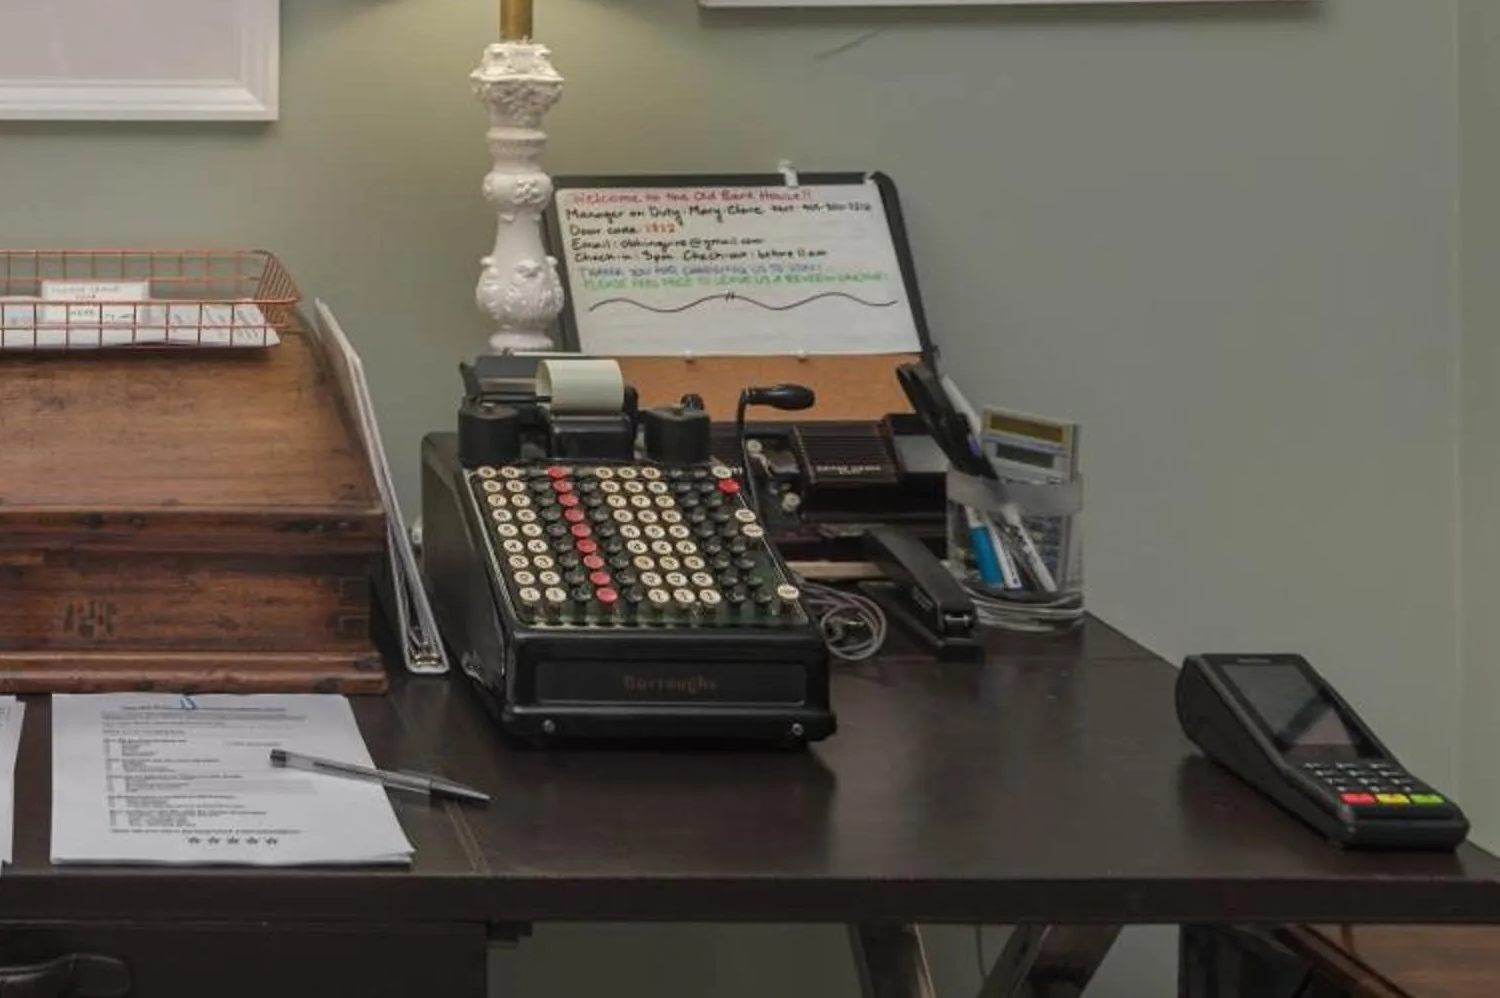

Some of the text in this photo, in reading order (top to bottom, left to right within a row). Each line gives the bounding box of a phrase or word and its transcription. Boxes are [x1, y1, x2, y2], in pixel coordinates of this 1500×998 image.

[573, 192, 642, 205] Welcome
[694, 191, 716, 201] Old
[565, 208, 623, 224] Manager
[569, 224, 601, 236] Door
